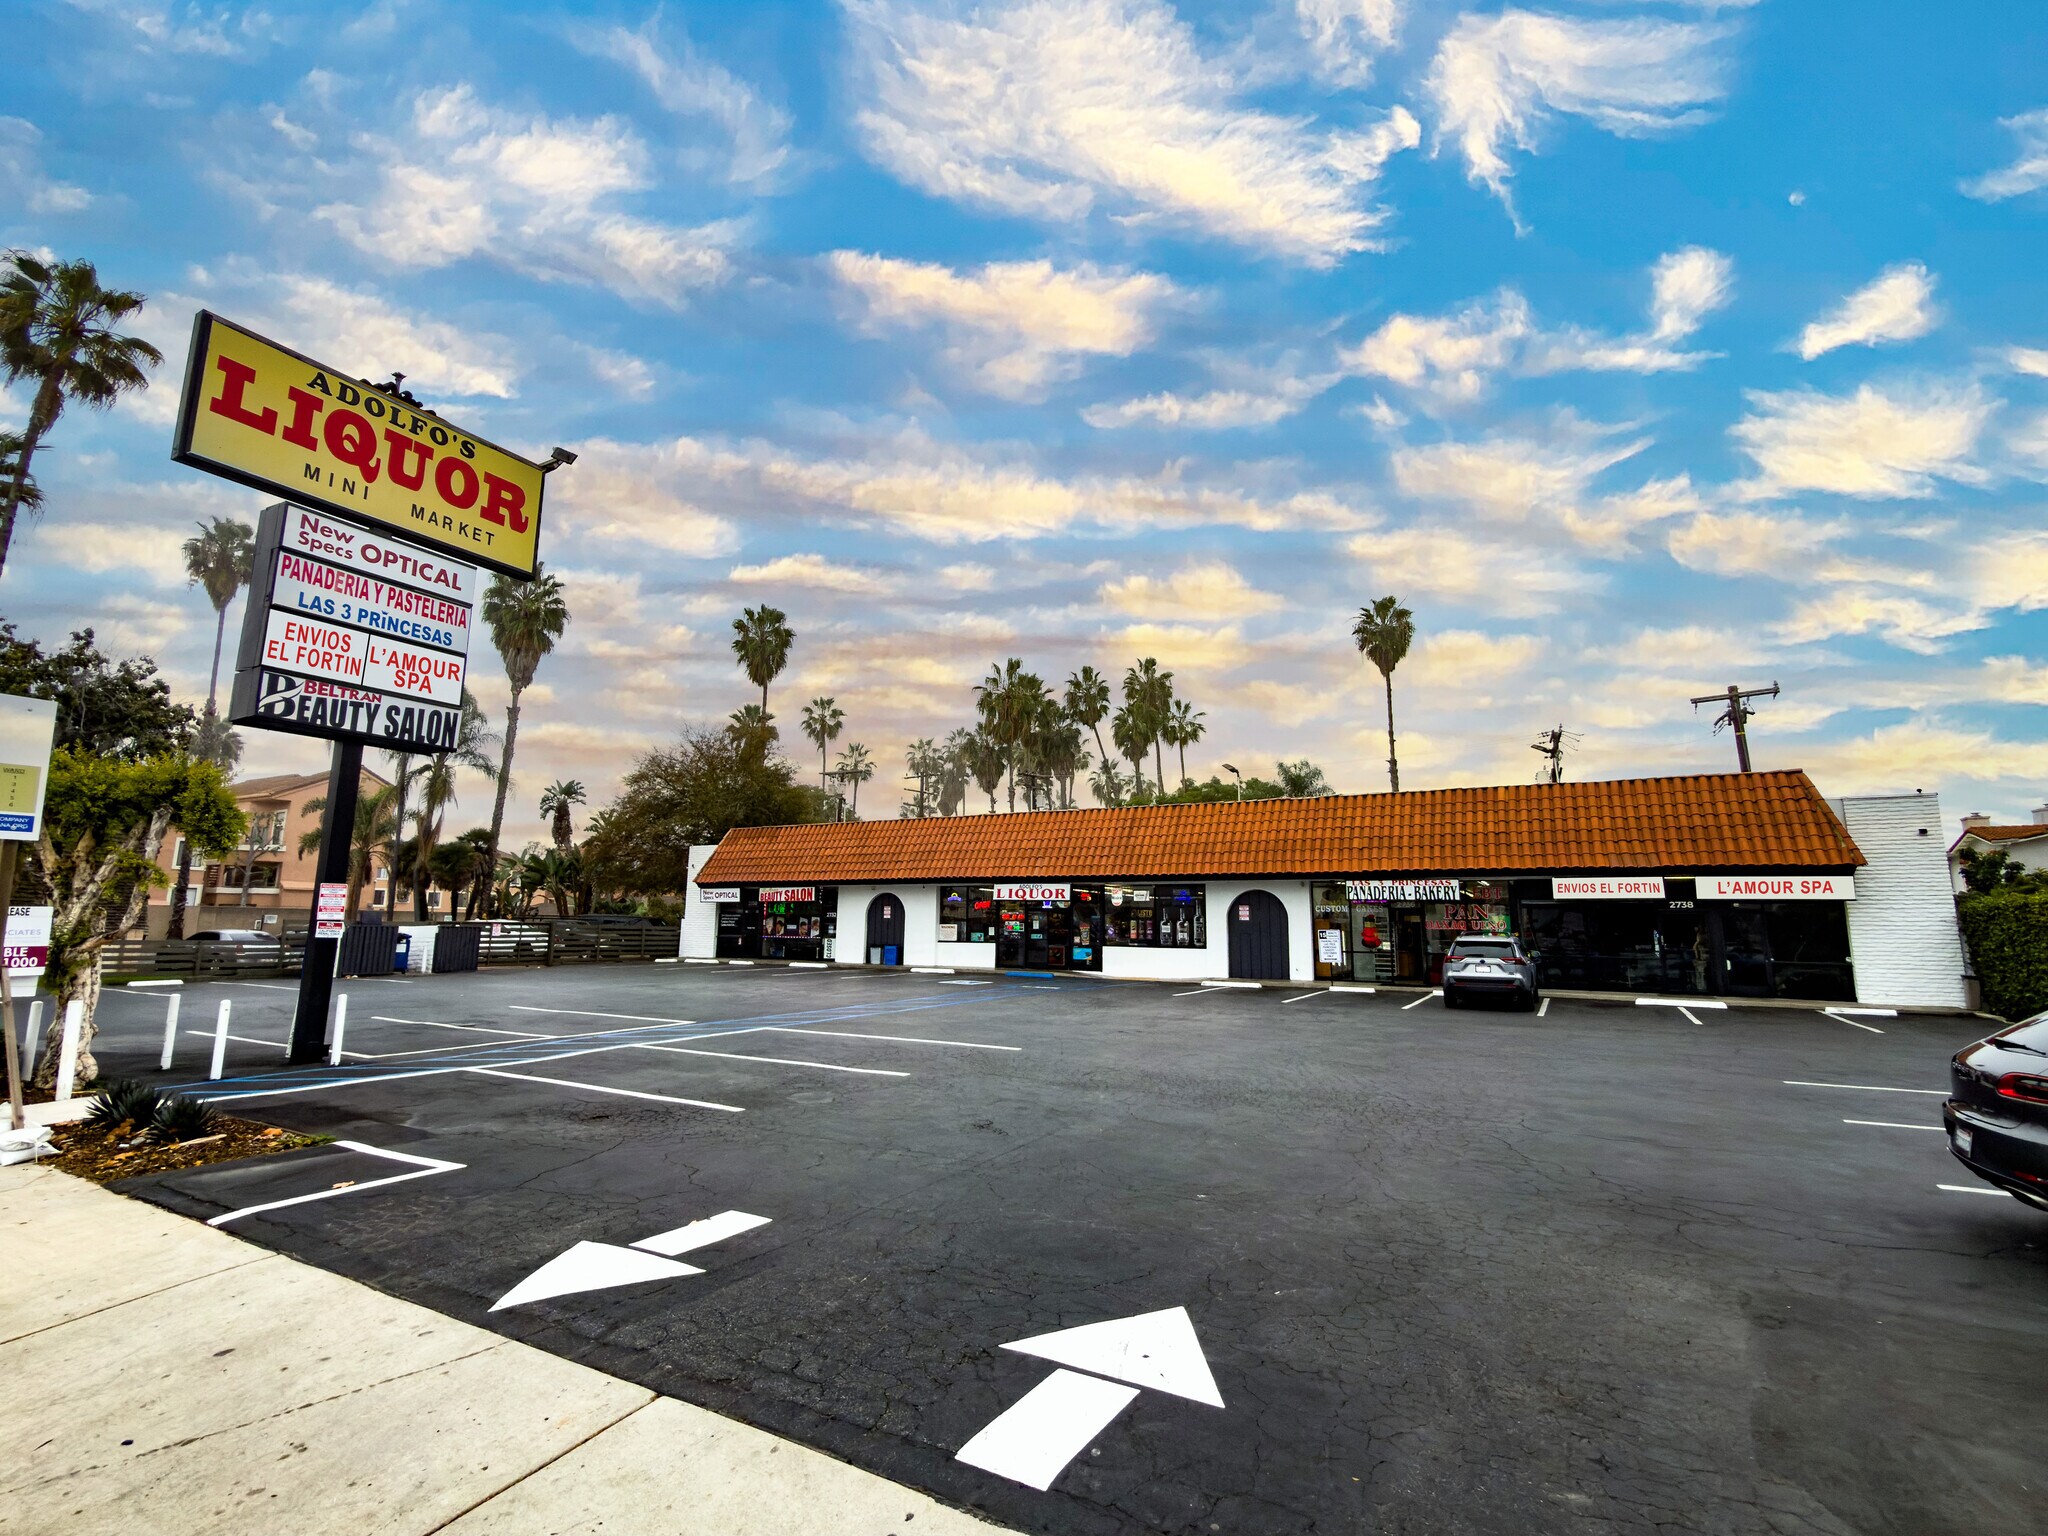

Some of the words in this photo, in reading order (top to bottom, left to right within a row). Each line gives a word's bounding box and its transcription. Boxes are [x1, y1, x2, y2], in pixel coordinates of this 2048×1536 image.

[306, 371, 477, 460] ADOLFO'S
[209, 354, 530, 534] LIQUOR
[303, 462, 370, 501] MINI
[410, 503, 496, 547] MARKET
[300, 513, 355, 544] New
[297, 530, 354, 560] Specs
[360, 543, 463, 592] OPTICAL
[280, 554, 370, 602] PANADERIA
[373, 582, 385, 604] Y
[387, 586, 468, 629] PASTELERIA
[297, 591, 336, 616] LAS
[340, 603, 352, 620] 3
[357, 607, 454, 647] PRINCESAS
[284, 621, 352, 653] ENVIOS
[266, 639, 290, 662] EL
[295, 646, 362, 678] FORTIN
[368, 646, 462, 682] L'AMOUR
[303, 680, 382, 703] BELTRAN
[393, 669, 433, 694] SPA
[258, 671, 382, 736] BEAUTY
[384, 704, 458, 749] SALON
[714, 891, 739, 899] OPTICAL
[760, 891, 784, 901] BEAUTY
[784, 887, 814, 901] SALON
[996, 888, 1067, 900] LIQUOR
[1347, 885, 1406, 900] PANADERIA
[1414, 885, 1458, 900] BAKERY
[1557, 883, 1597, 894] ENVIOS
[1600, 883, 1615, 894] EL
[1617, 882, 1661, 894] FORTIN
[1717, 881, 1794, 895] L'AMOUR
[1800, 880, 1834, 895] SPA
[6, 906, 31, 917] EASE
[1315, 904, 1349, 913] CUSTOM
[1443, 903, 1491, 920] PAN
[1669, 901, 1694, 909] 2738
[6, 928, 42, 937] CIATES
[3, 946, 29, 958] BLE
